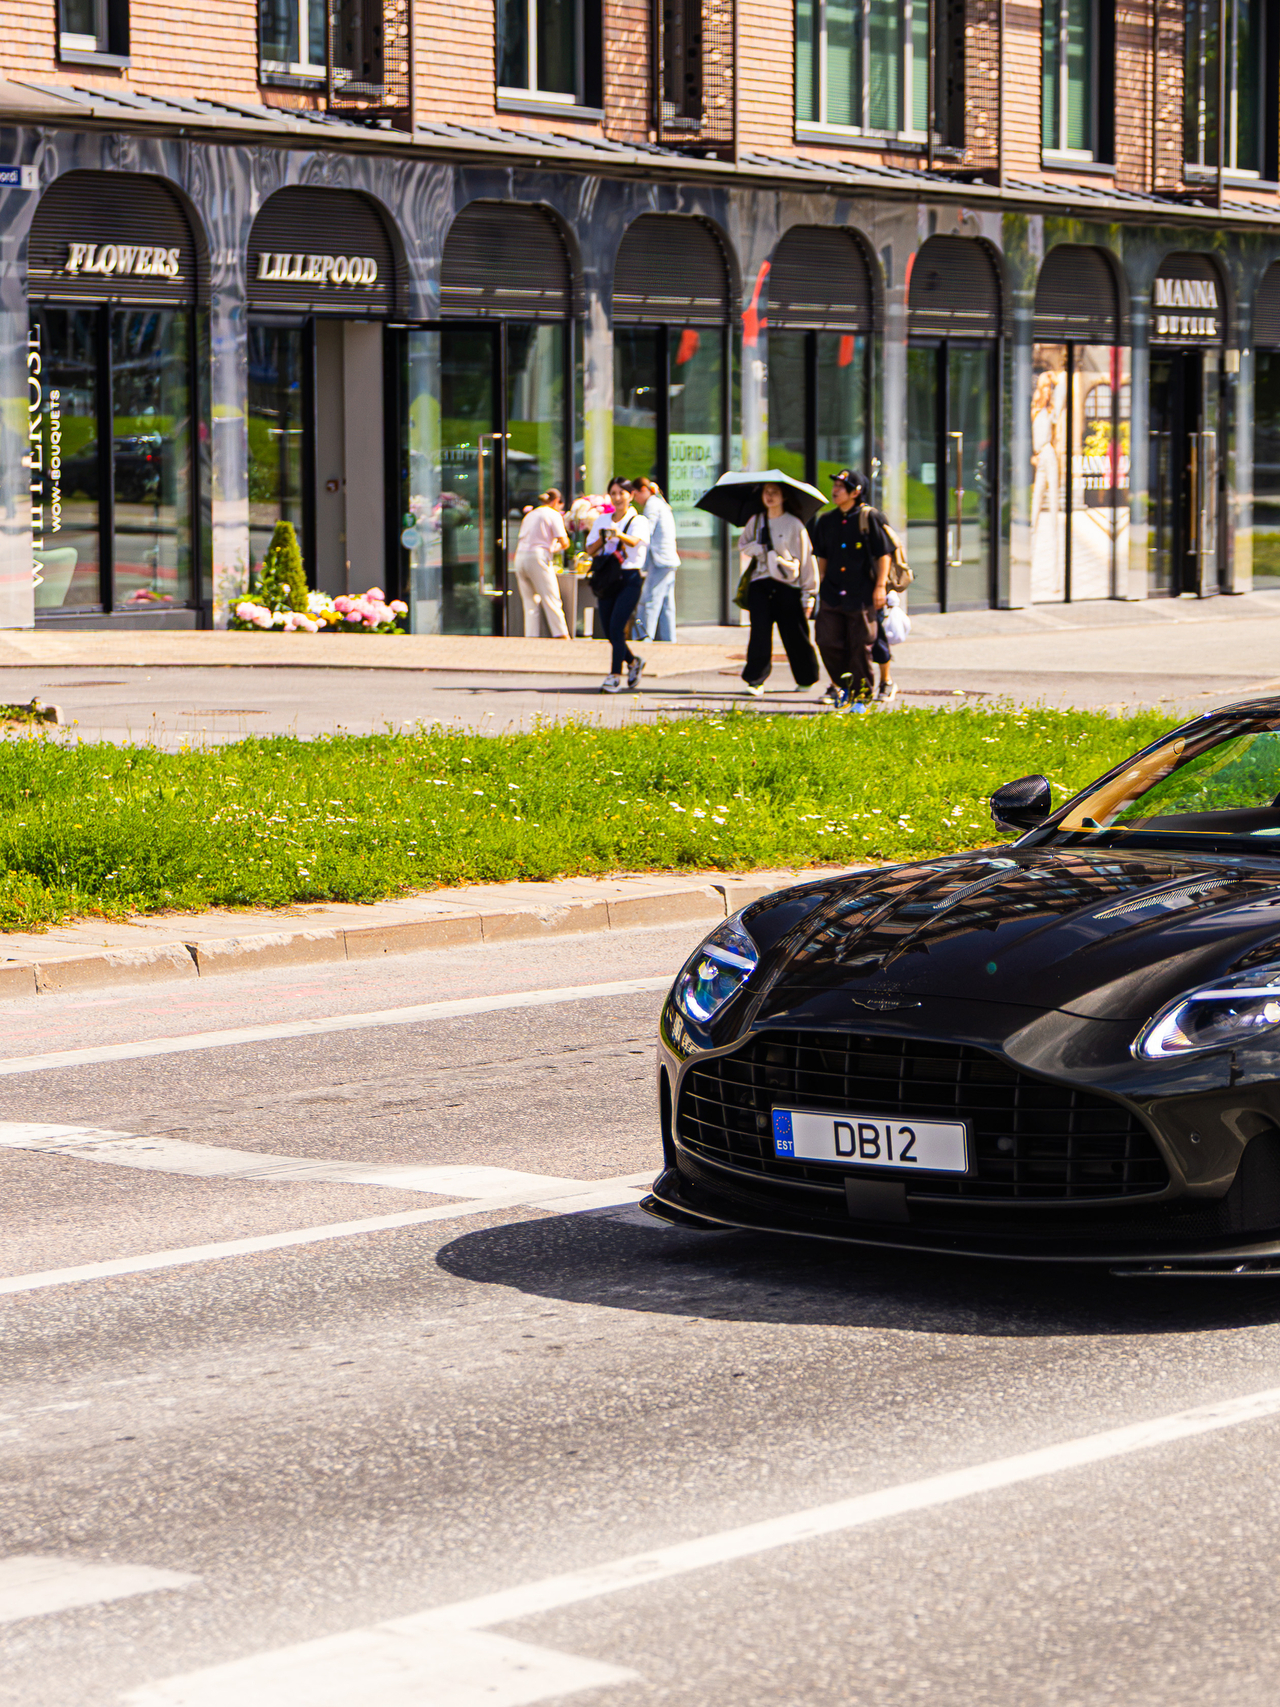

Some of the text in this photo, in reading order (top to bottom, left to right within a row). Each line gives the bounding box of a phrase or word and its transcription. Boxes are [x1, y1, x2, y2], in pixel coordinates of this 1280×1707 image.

[65, 243, 180, 276] FLOWERS
[257, 252, 378, 284] LILLEPOOD
[1155, 278, 1218, 310] MANNA
[1157, 315, 1217, 335] BUTIIK
[50, 389, 62, 533] WOW-BOUQUETS
[776, 1140, 793, 1151] EST
